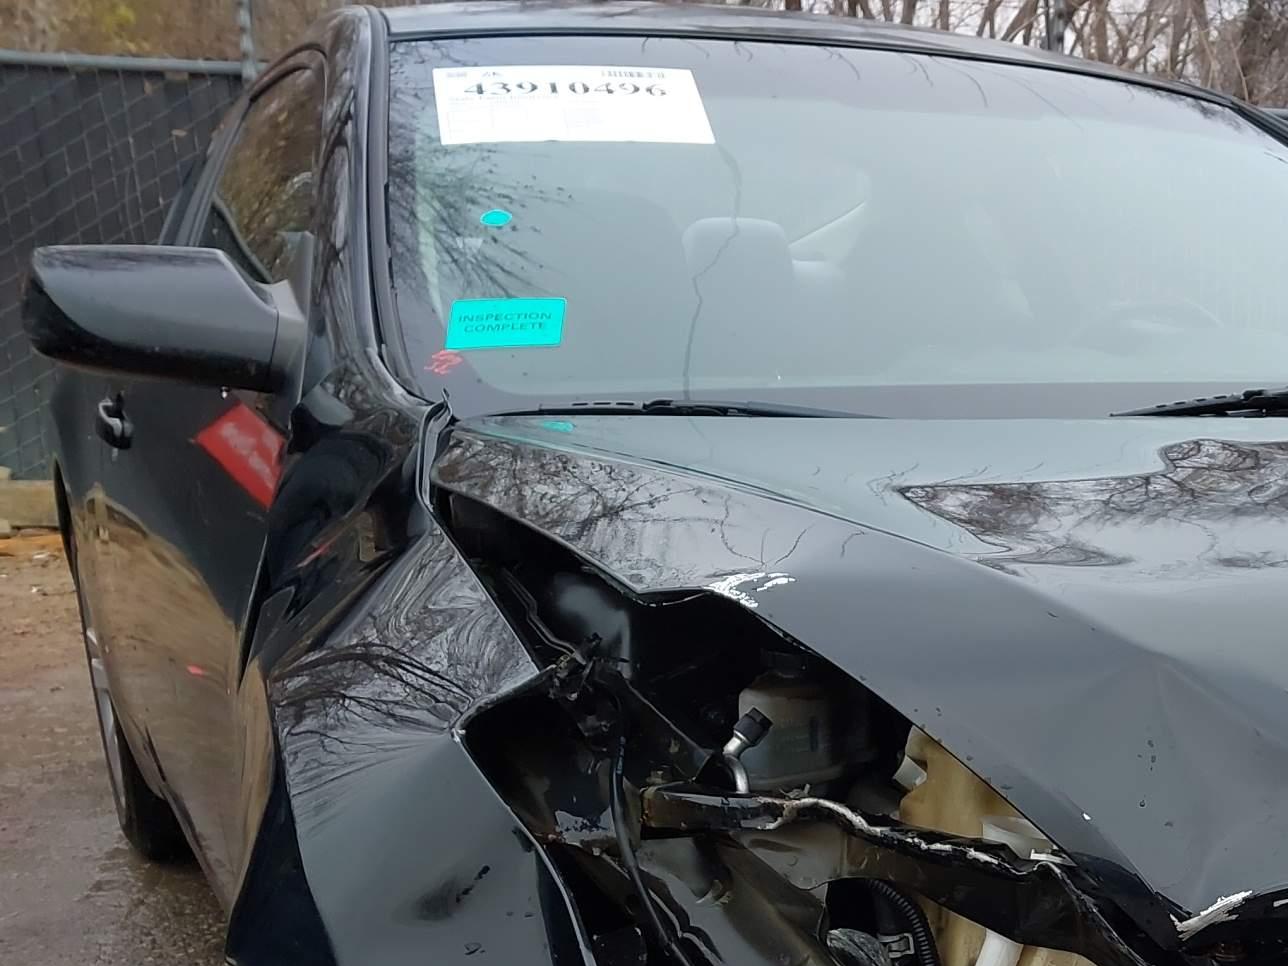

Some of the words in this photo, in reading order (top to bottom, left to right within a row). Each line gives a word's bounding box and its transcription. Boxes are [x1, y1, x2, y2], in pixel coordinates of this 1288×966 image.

[463, 80, 667, 97] 43910496
[458, 311, 552, 323] INSPECTION
[464, 321, 545, 333] COMPLETE
